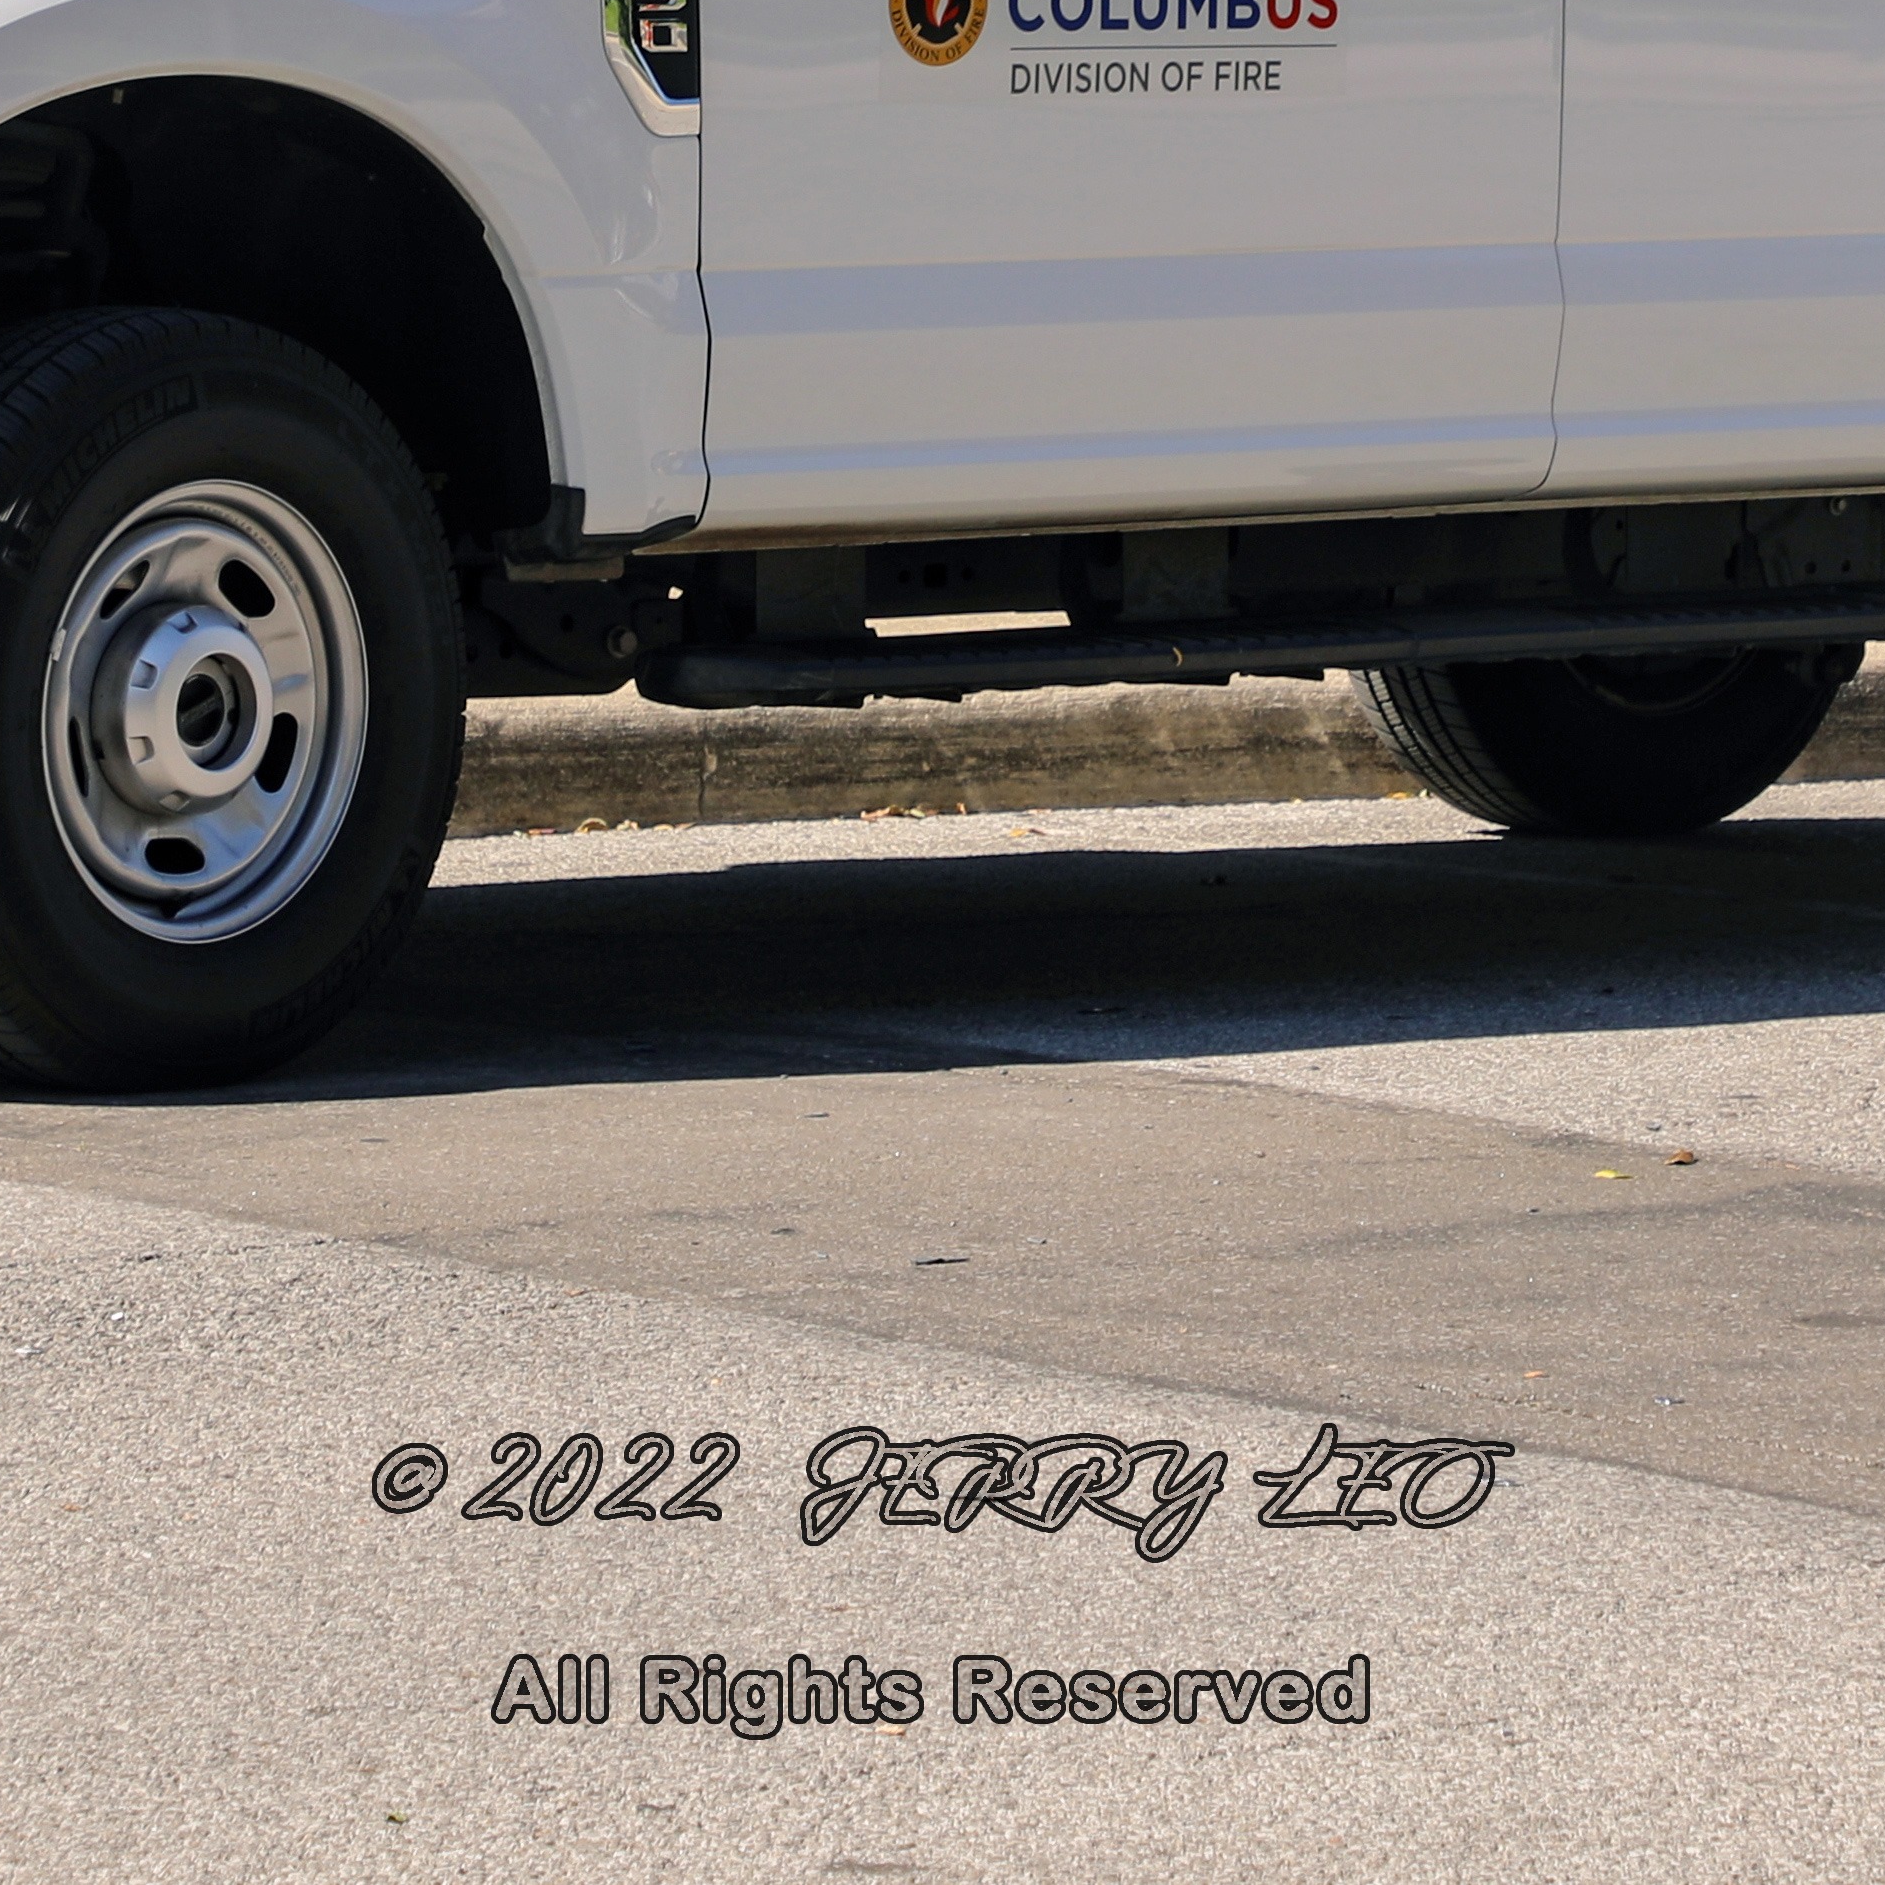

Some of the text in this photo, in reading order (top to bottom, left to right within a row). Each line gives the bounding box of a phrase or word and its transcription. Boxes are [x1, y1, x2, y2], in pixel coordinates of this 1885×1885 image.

[892, 9, 985, 61] DIVISION OF FIRE
[1010, 60, 1282, 95] DIVISION OF FIRE
